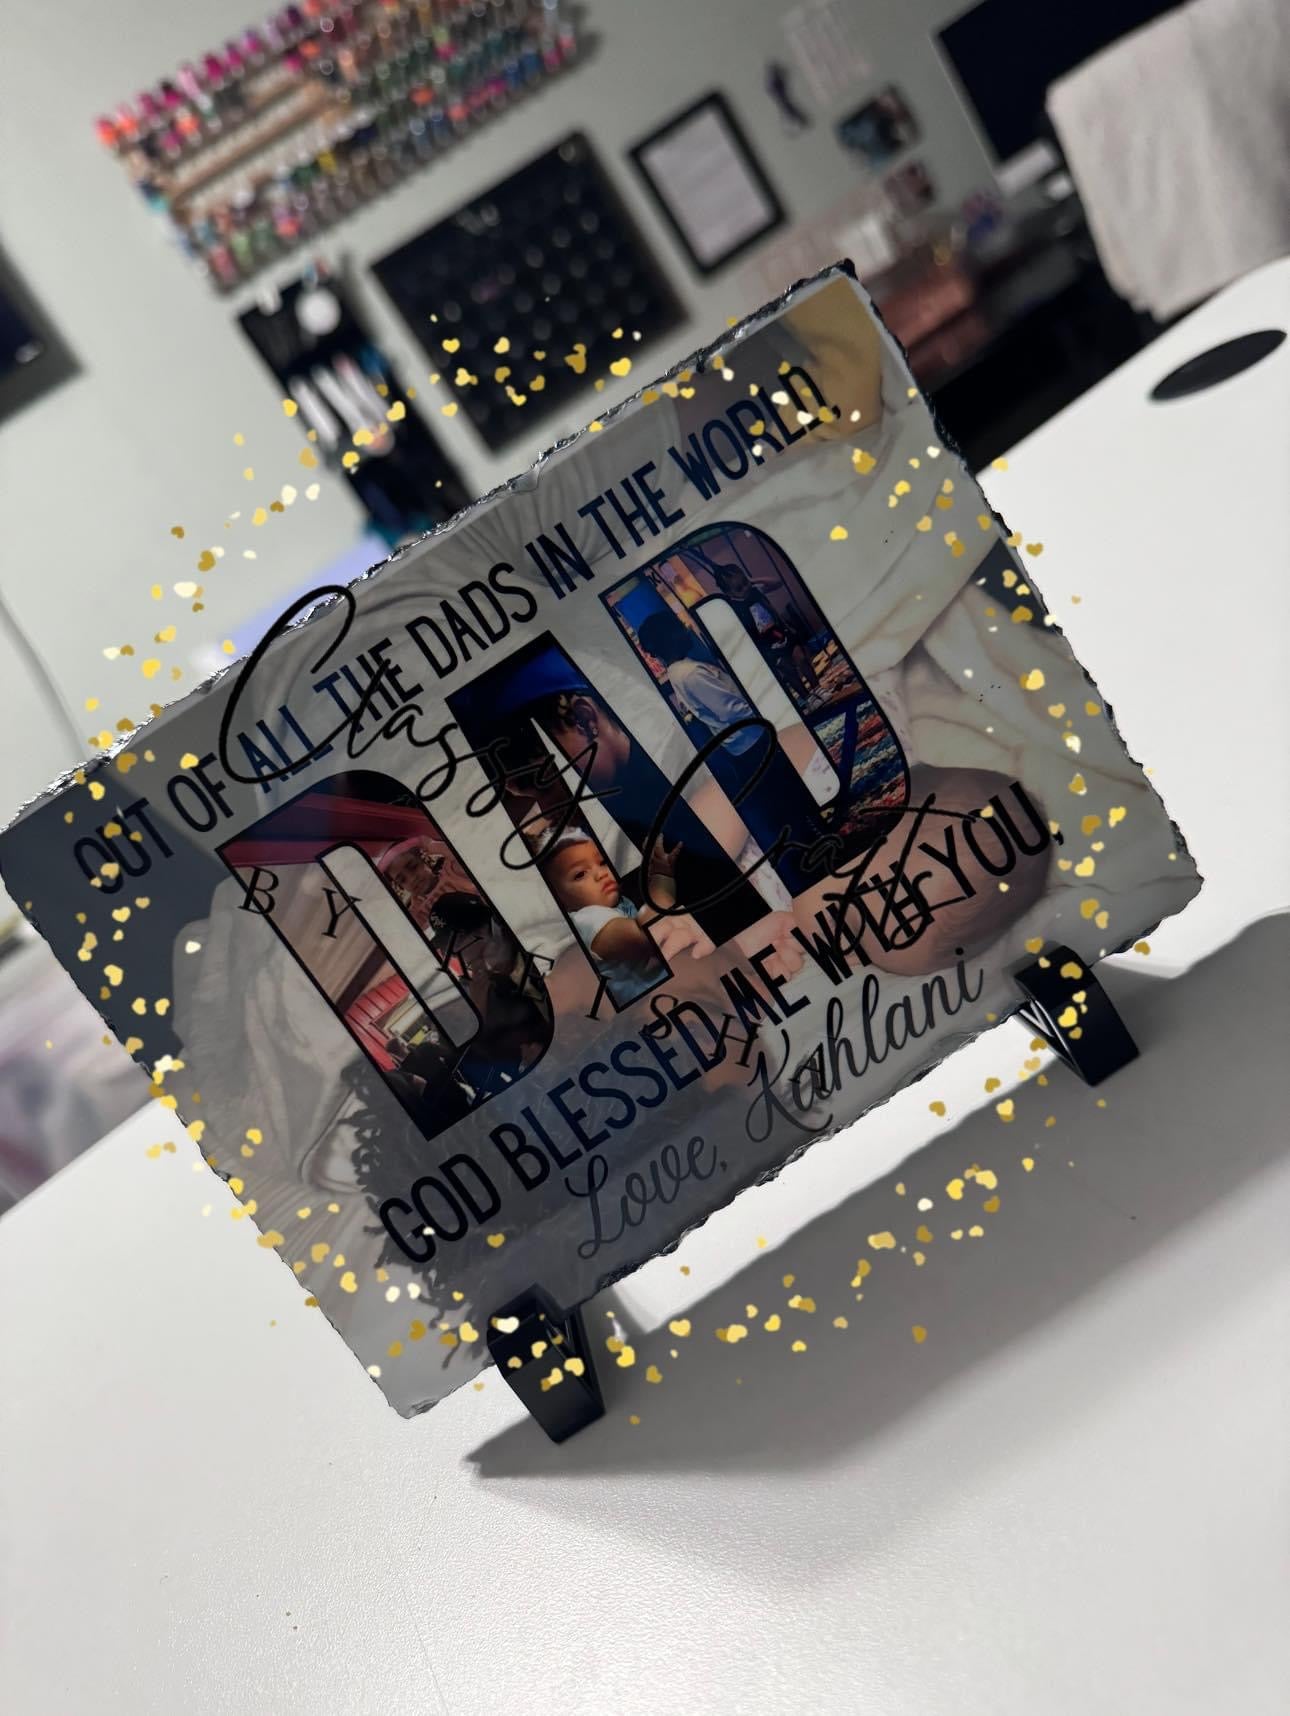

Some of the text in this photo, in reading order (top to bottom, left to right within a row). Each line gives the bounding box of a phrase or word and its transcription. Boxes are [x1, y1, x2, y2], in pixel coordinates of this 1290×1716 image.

[72, 798, 174, 895] OUT
[165, 753, 236, 834] OF
[236, 701, 333, 794] ALL
[312, 638, 424, 734] THE
[405, 562, 537, 679] DADS
[524, 521, 596, 600] IN
[577, 461, 684, 560] THE
[379, 781, 1065, 1264] GOD BLESSED ME WITH YOU,
[563, 946, 985, 1260] Love, Kahlani
